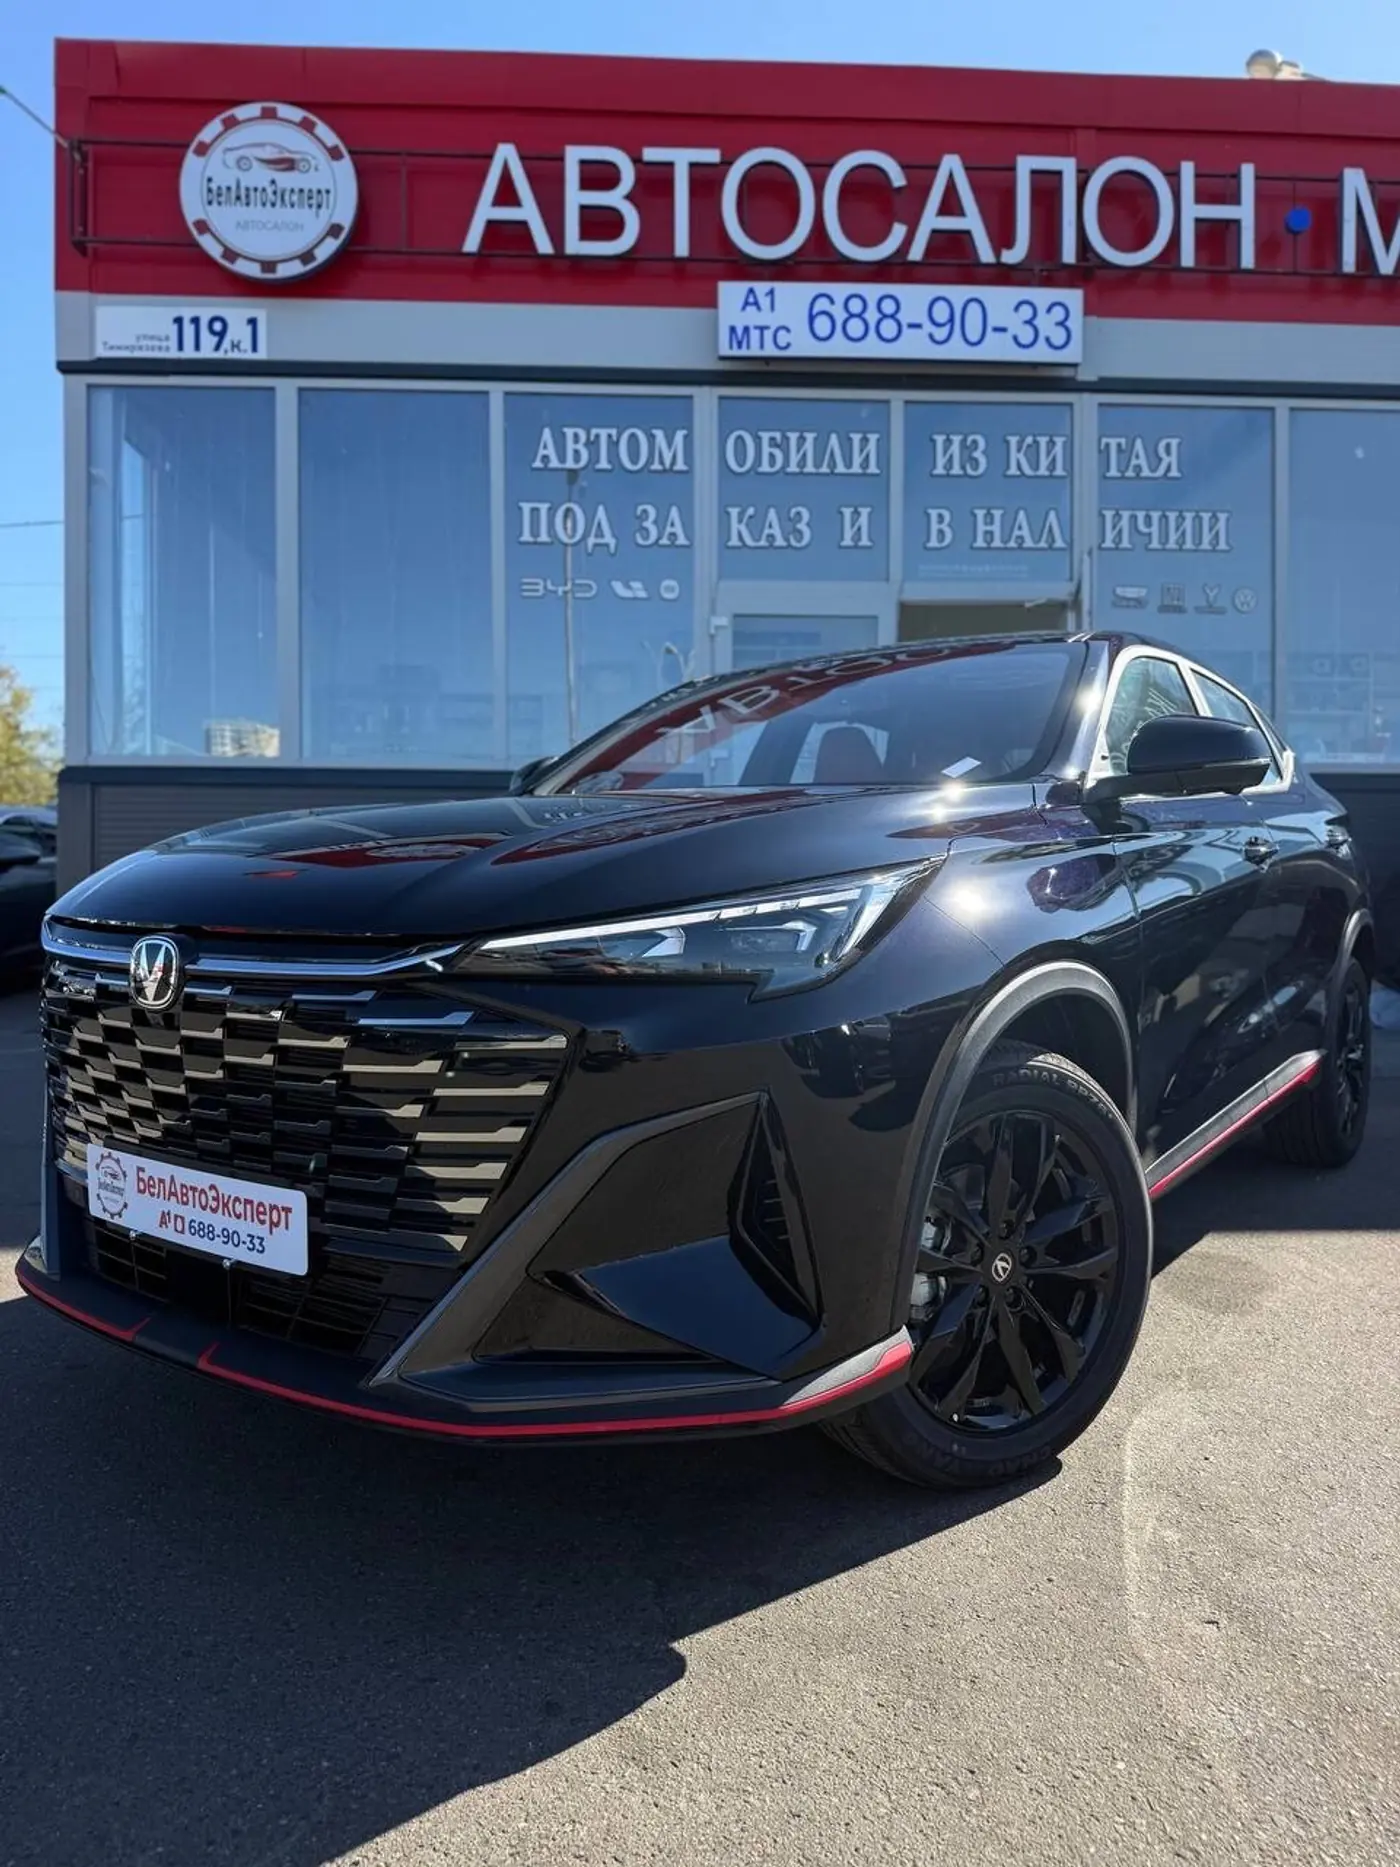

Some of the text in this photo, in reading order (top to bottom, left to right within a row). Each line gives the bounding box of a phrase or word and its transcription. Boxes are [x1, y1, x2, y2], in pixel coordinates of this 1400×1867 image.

[206, 176, 332, 219] БелАвтоЭксперт
[461, 142, 1255, 270] АВТОСАЛОН
[235, 219, 304, 233] АВТОСАЛОН
[740, 286, 776, 313] A1
[728, 325, 792, 351] МТС
[807, 292, 1074, 351] 688-90-33
[931, 433, 988, 477] ИЗ
[518, 501, 617, 554] ПОД
[839, 506, 874, 547] И
[925, 507, 954, 549] В
[520, 577, 598, 597] BYD
[136, 1167, 293, 1235] БелАвтоЭксперт
[187, 1217, 266, 1255] 688-90-33
